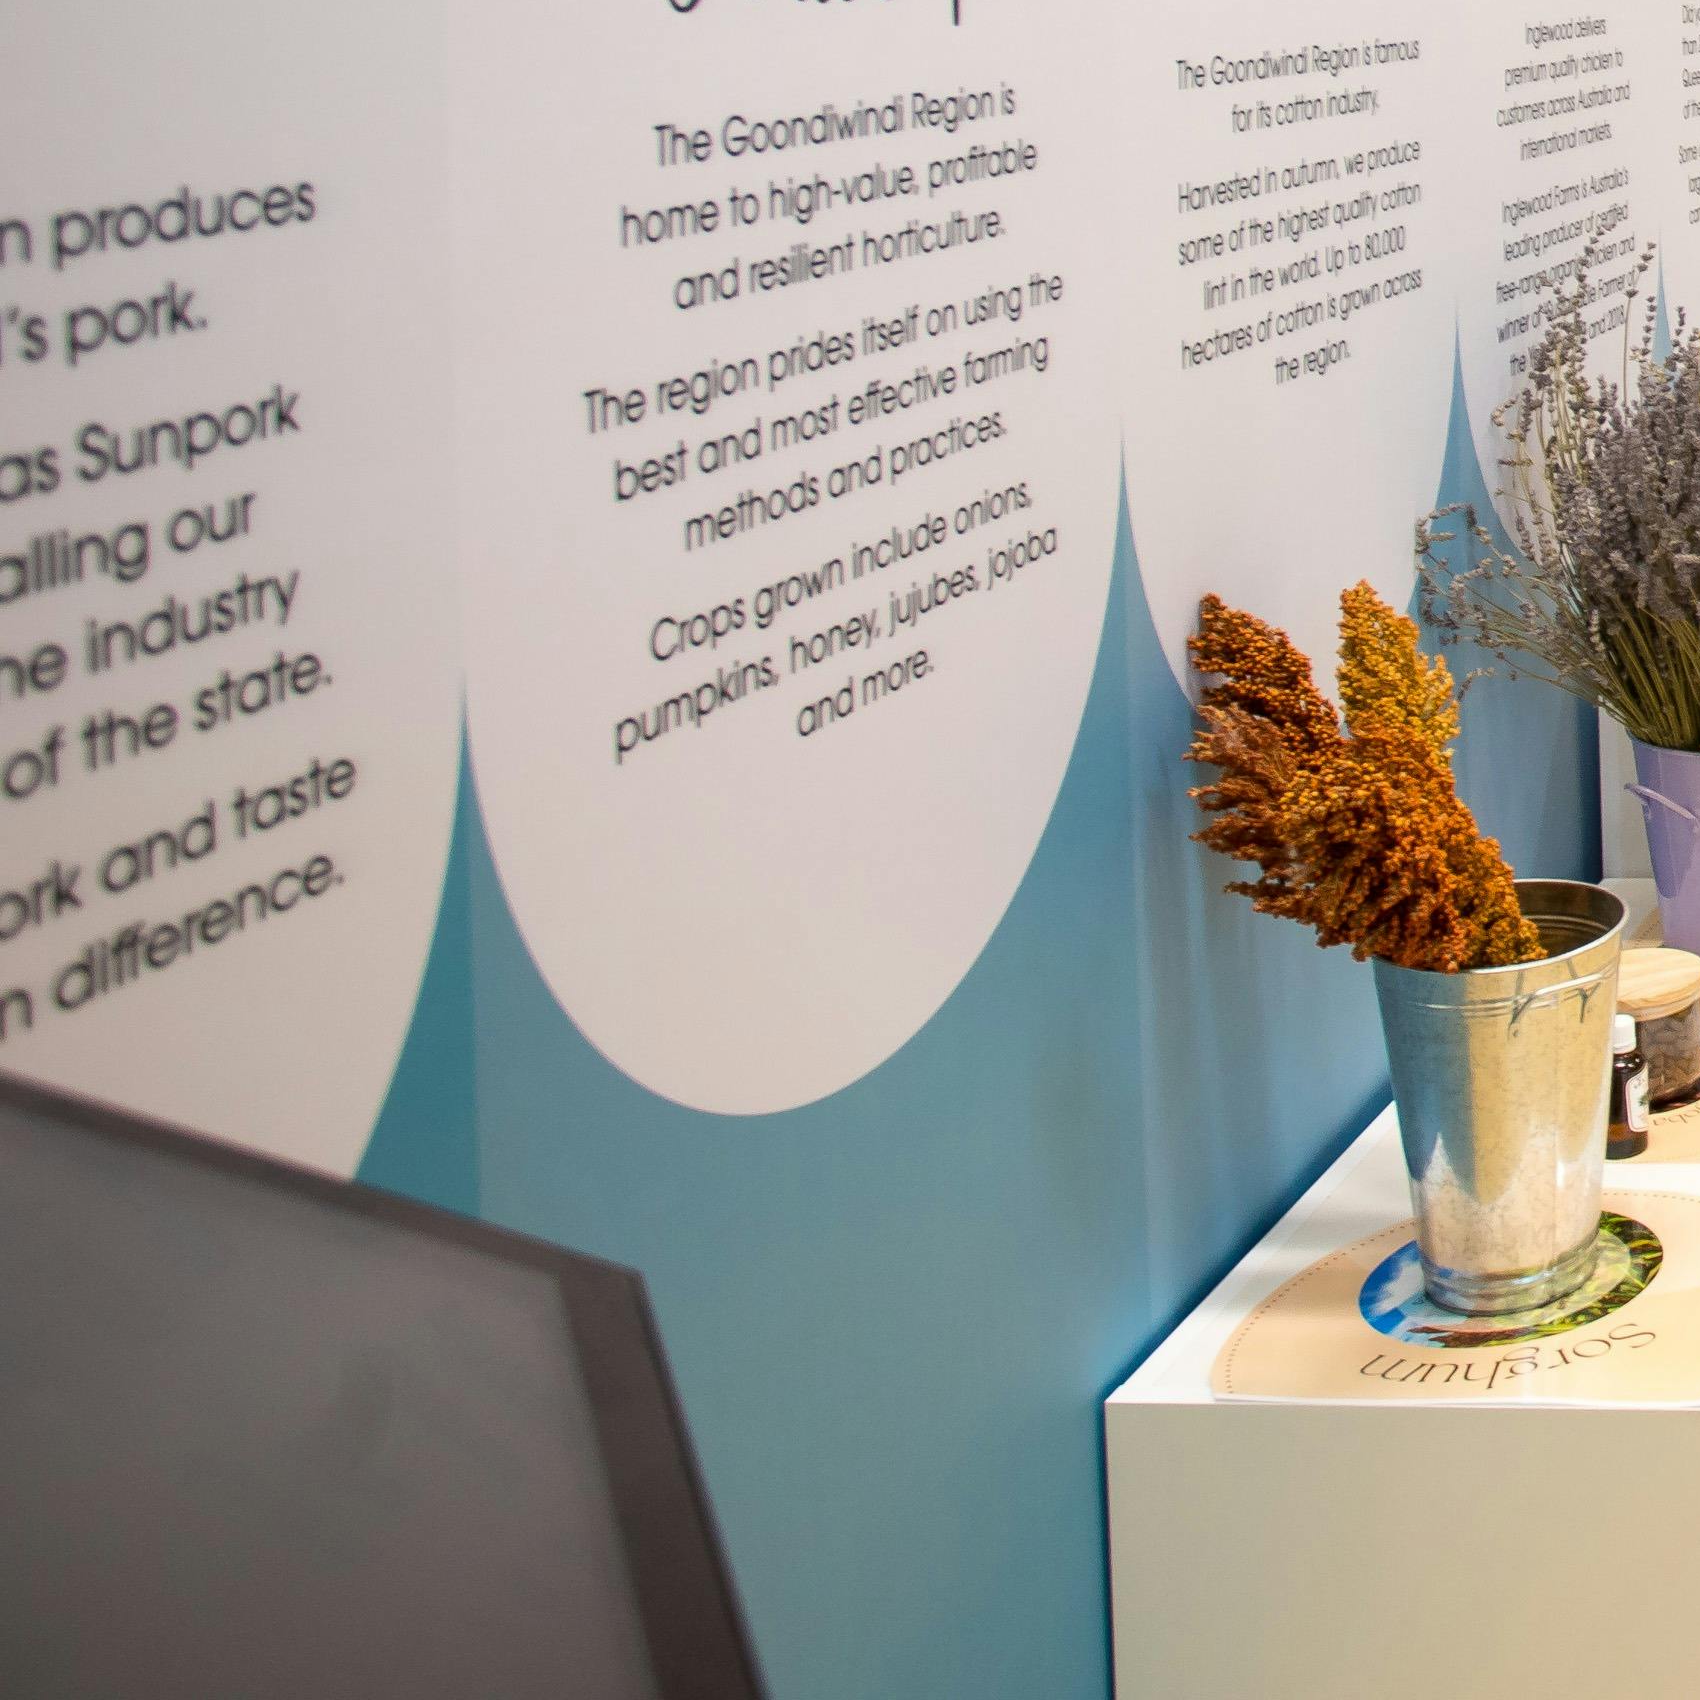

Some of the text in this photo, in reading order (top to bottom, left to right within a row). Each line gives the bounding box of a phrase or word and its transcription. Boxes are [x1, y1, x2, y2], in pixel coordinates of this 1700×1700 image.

[654, 89, 1015, 165] The Goondiwindi Region is
[49, 182, 316, 272] produces
[622, 143, 1036, 245] home to high-value, profitable
[64, 283, 207, 366] pork.
[1274, 338, 1352, 385] the region.
[74, 385, 299, 483] Sunpork
[165, 493, 255, 554] our
[85, 569, 300, 675] industry
[194, 651, 333, 731] state.
[1360, 1322, 1657, 1390] Sorghum
